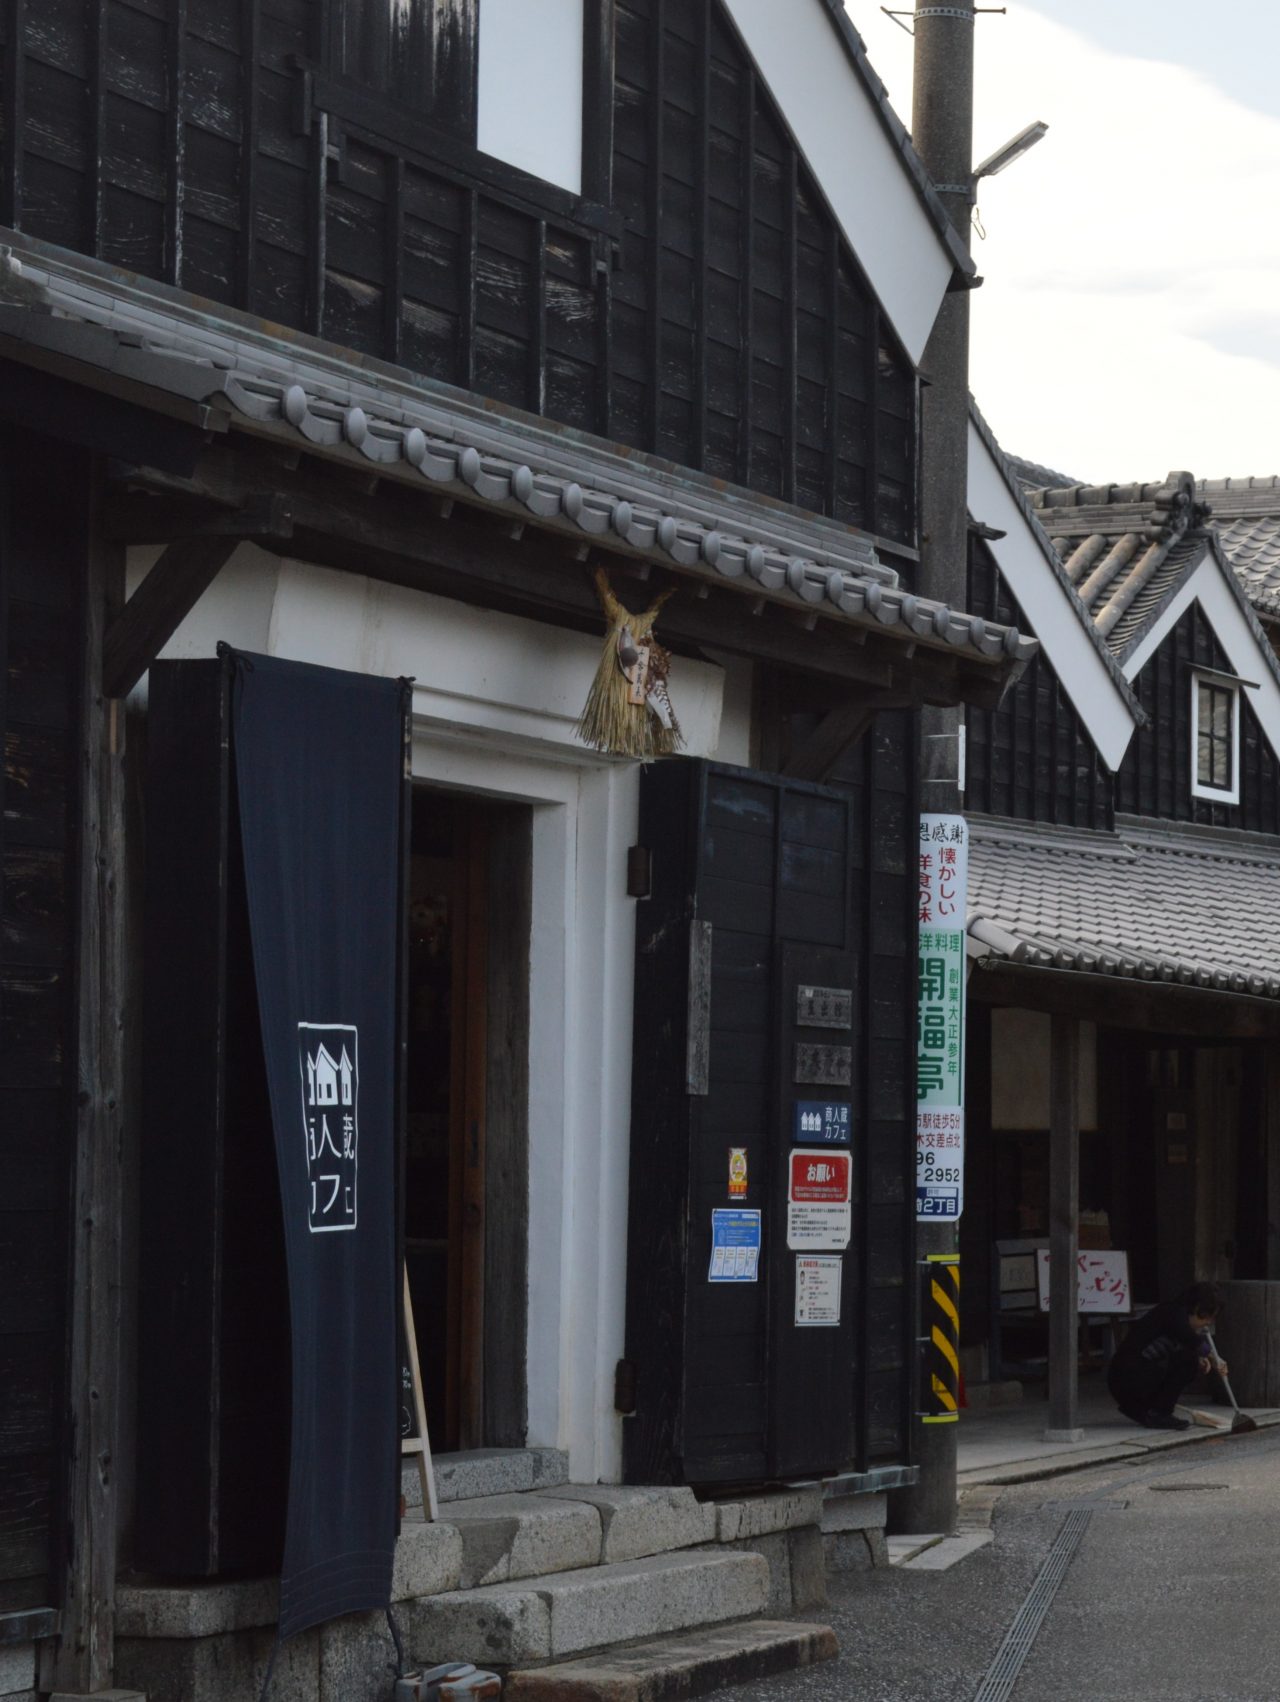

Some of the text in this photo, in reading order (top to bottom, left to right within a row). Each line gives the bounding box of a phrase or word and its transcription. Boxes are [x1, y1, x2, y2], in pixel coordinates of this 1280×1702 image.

[938, 847, 957, 915] 懐かしい
[918, 933, 960, 952] 洋料理
[825, 1105, 848, 1122] 商人蔵
[825, 1119, 847, 1140] カフェ
[916, 1152, 935, 1165] 96
[806, 1163, 835, 1183] お願い
